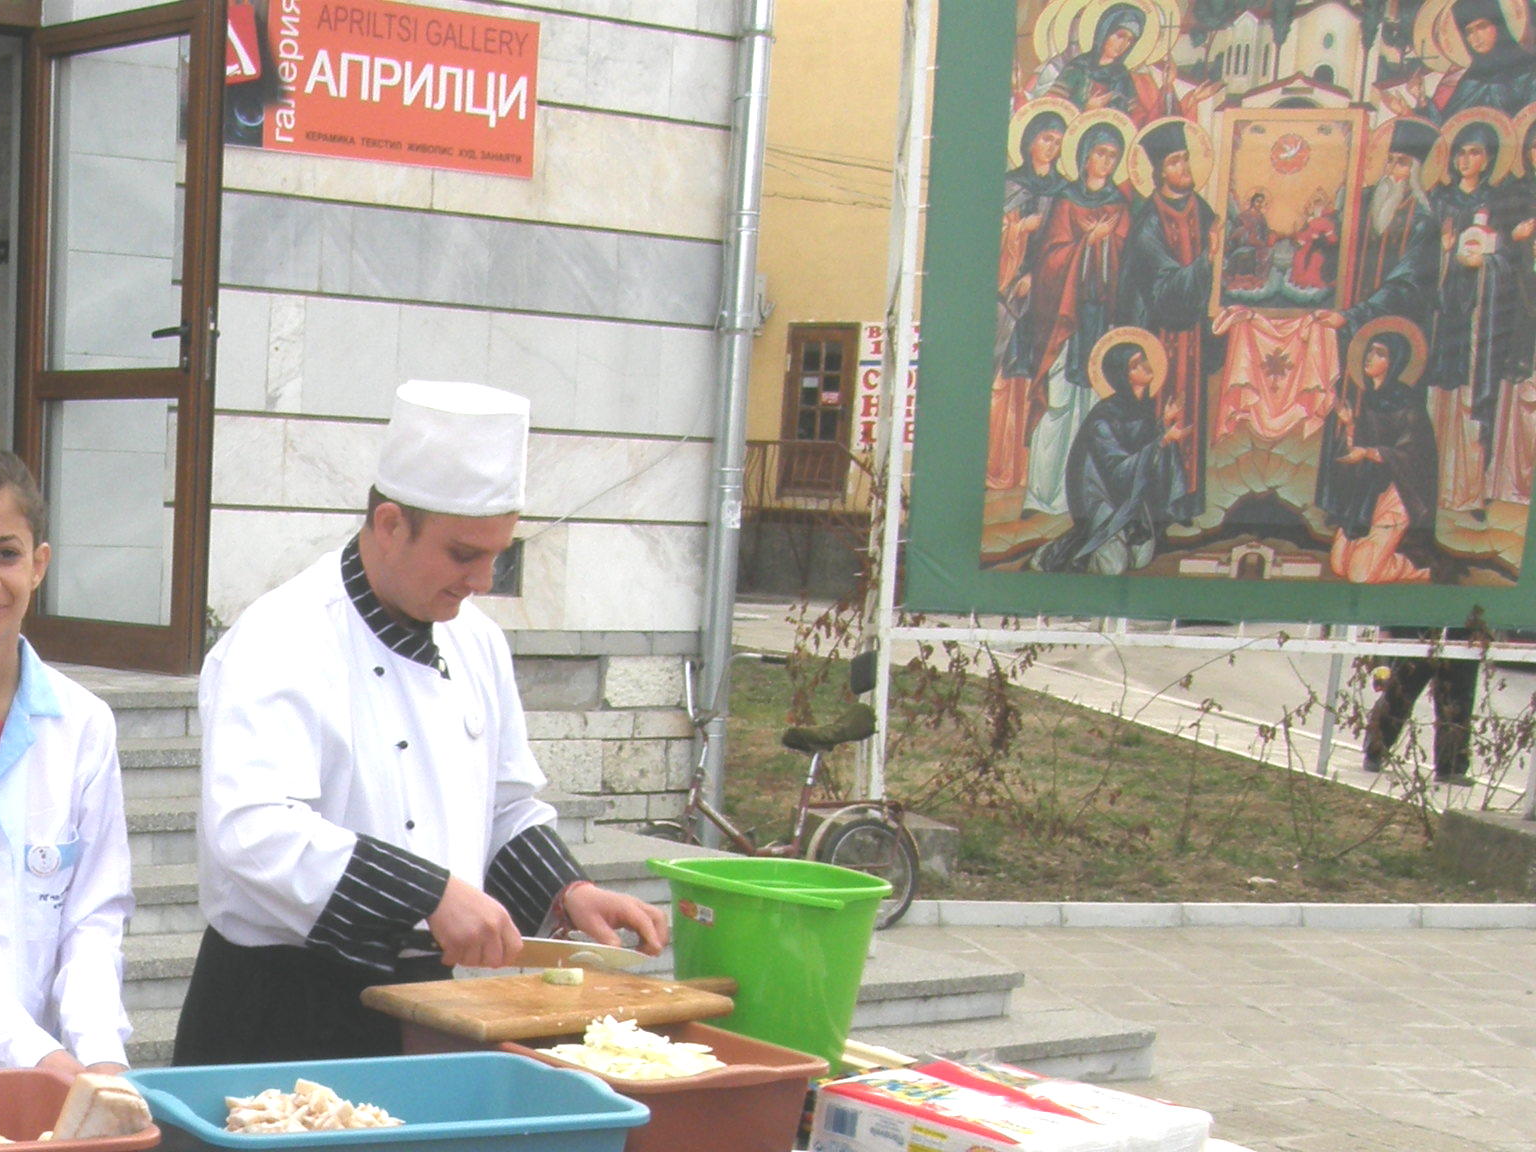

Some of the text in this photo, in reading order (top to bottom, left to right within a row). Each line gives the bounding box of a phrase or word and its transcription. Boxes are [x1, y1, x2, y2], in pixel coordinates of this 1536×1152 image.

[317, 4, 529, 58] APRILTSI GALLERY
[275, 0, 304, 143] галерия
[304, 49, 528, 128] АПРИЛЦИ
